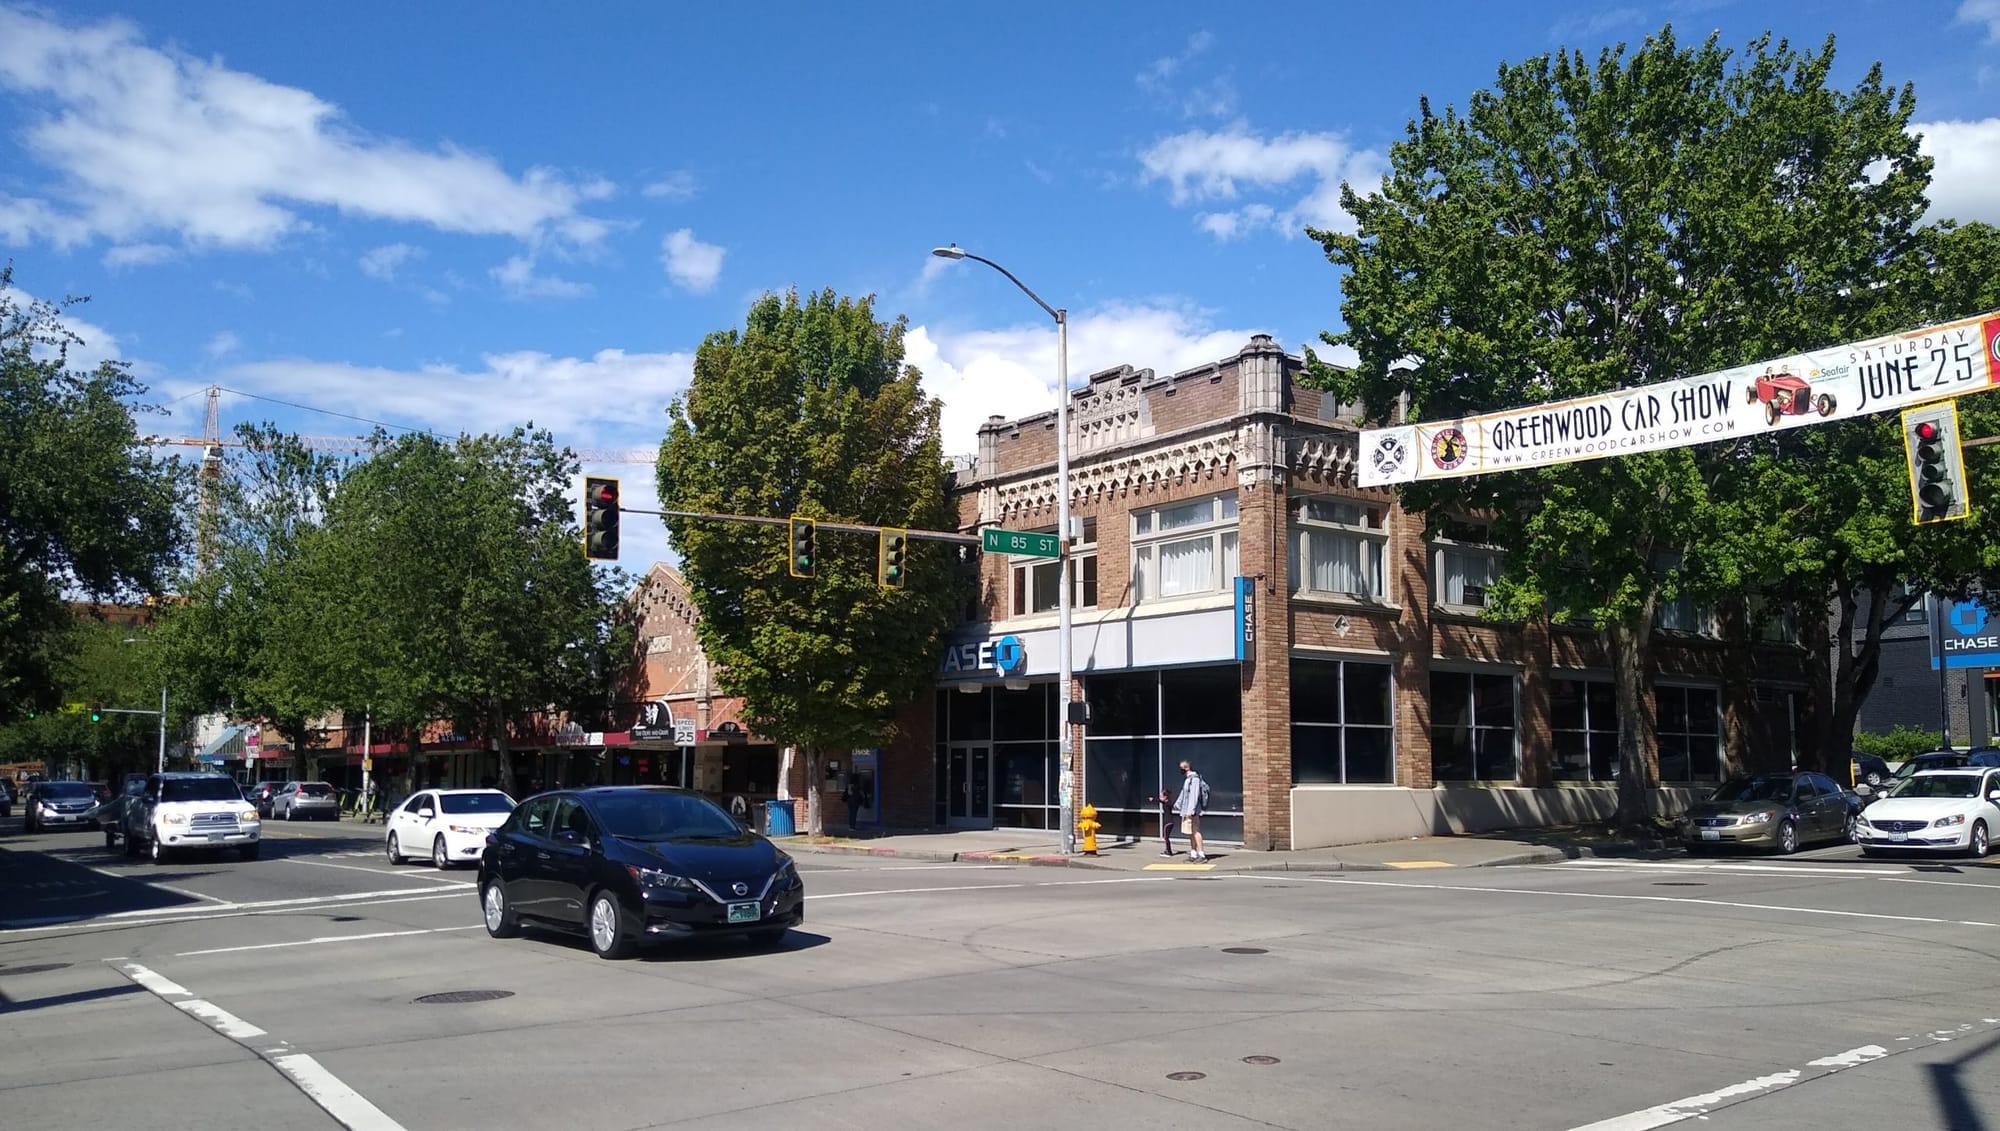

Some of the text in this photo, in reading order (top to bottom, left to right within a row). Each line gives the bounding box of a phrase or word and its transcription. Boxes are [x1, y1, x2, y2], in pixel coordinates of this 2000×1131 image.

[1849, 329, 1966, 364] SATURDAY
[1820, 365, 1850, 378] Seafair
[1856, 343, 1973, 411] JUNE 25
[1493, 380, 1733, 451] GREENWOOD CAR SHOW
[989, 534, 1054, 552] N 85 ST
[1244, 595, 1254, 642] CHASE
[941, 641, 994, 672] ASE
[1944, 636, 1999, 650] CHASE
[677, 731, 694, 743] 25
